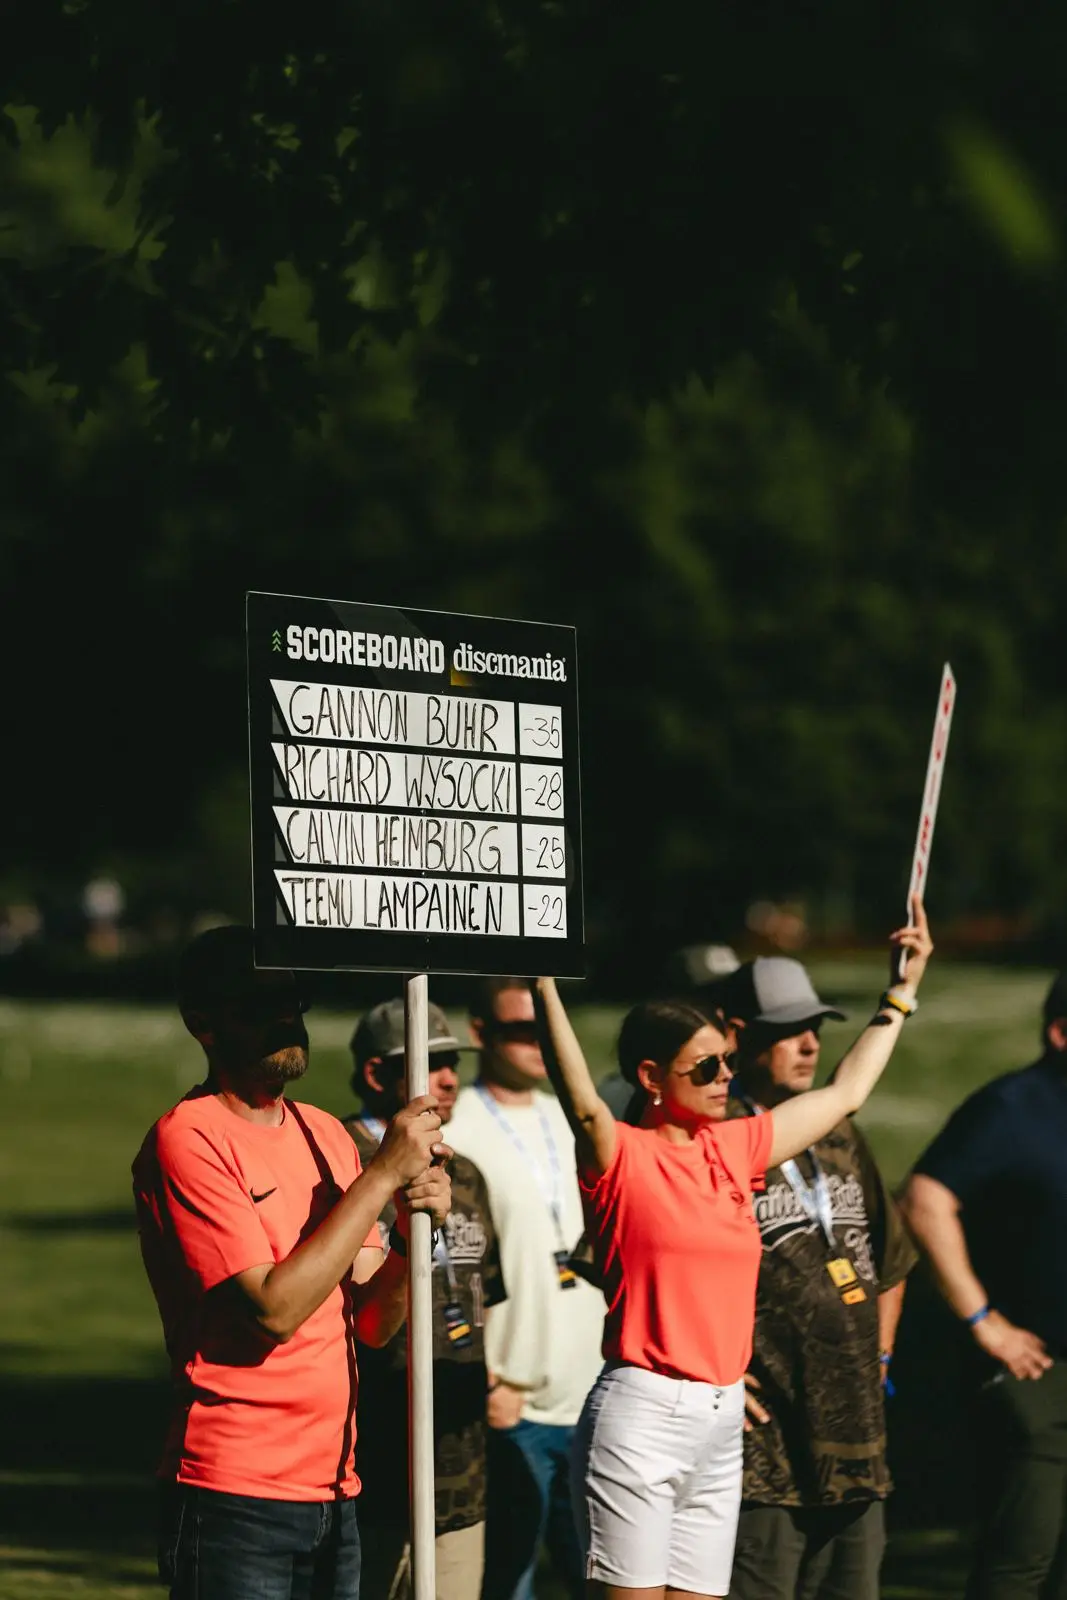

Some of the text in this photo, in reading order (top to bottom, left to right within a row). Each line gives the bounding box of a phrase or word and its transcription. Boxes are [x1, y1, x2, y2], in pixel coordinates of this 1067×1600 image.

[287, 625, 445, 673] SCOREBOARD
[453, 643, 567, 682] discmania
[289, 685, 560, 751] GANNON BUHR -35
[284, 743, 562, 813] RICHARD WYSOCKI -28
[286, 810, 565, 874] CALVIN HEIMBURG -25
[281, 877, 564, 934] TEEMU LAMPAINEN -22
